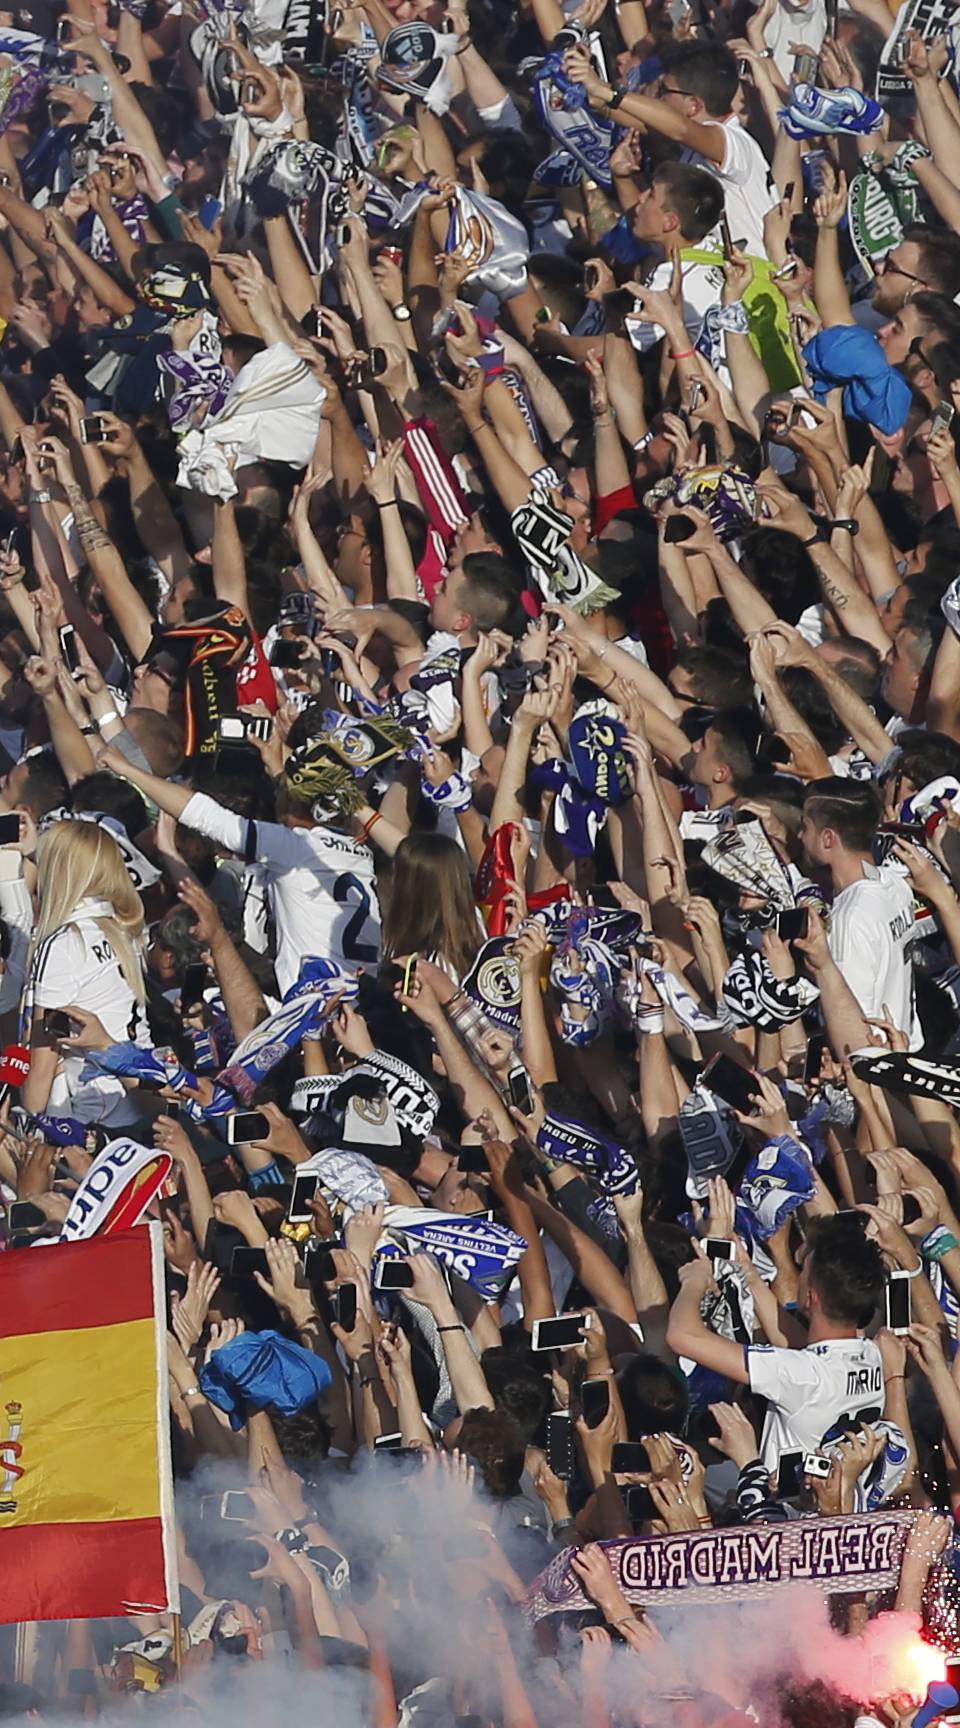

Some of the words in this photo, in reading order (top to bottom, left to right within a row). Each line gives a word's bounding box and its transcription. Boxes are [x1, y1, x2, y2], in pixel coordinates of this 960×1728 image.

[10, 1056, 31, 1074] rne
[422, 1228, 447, 1244] ARENA
[448, 1236, 498, 1255] VELTINS
